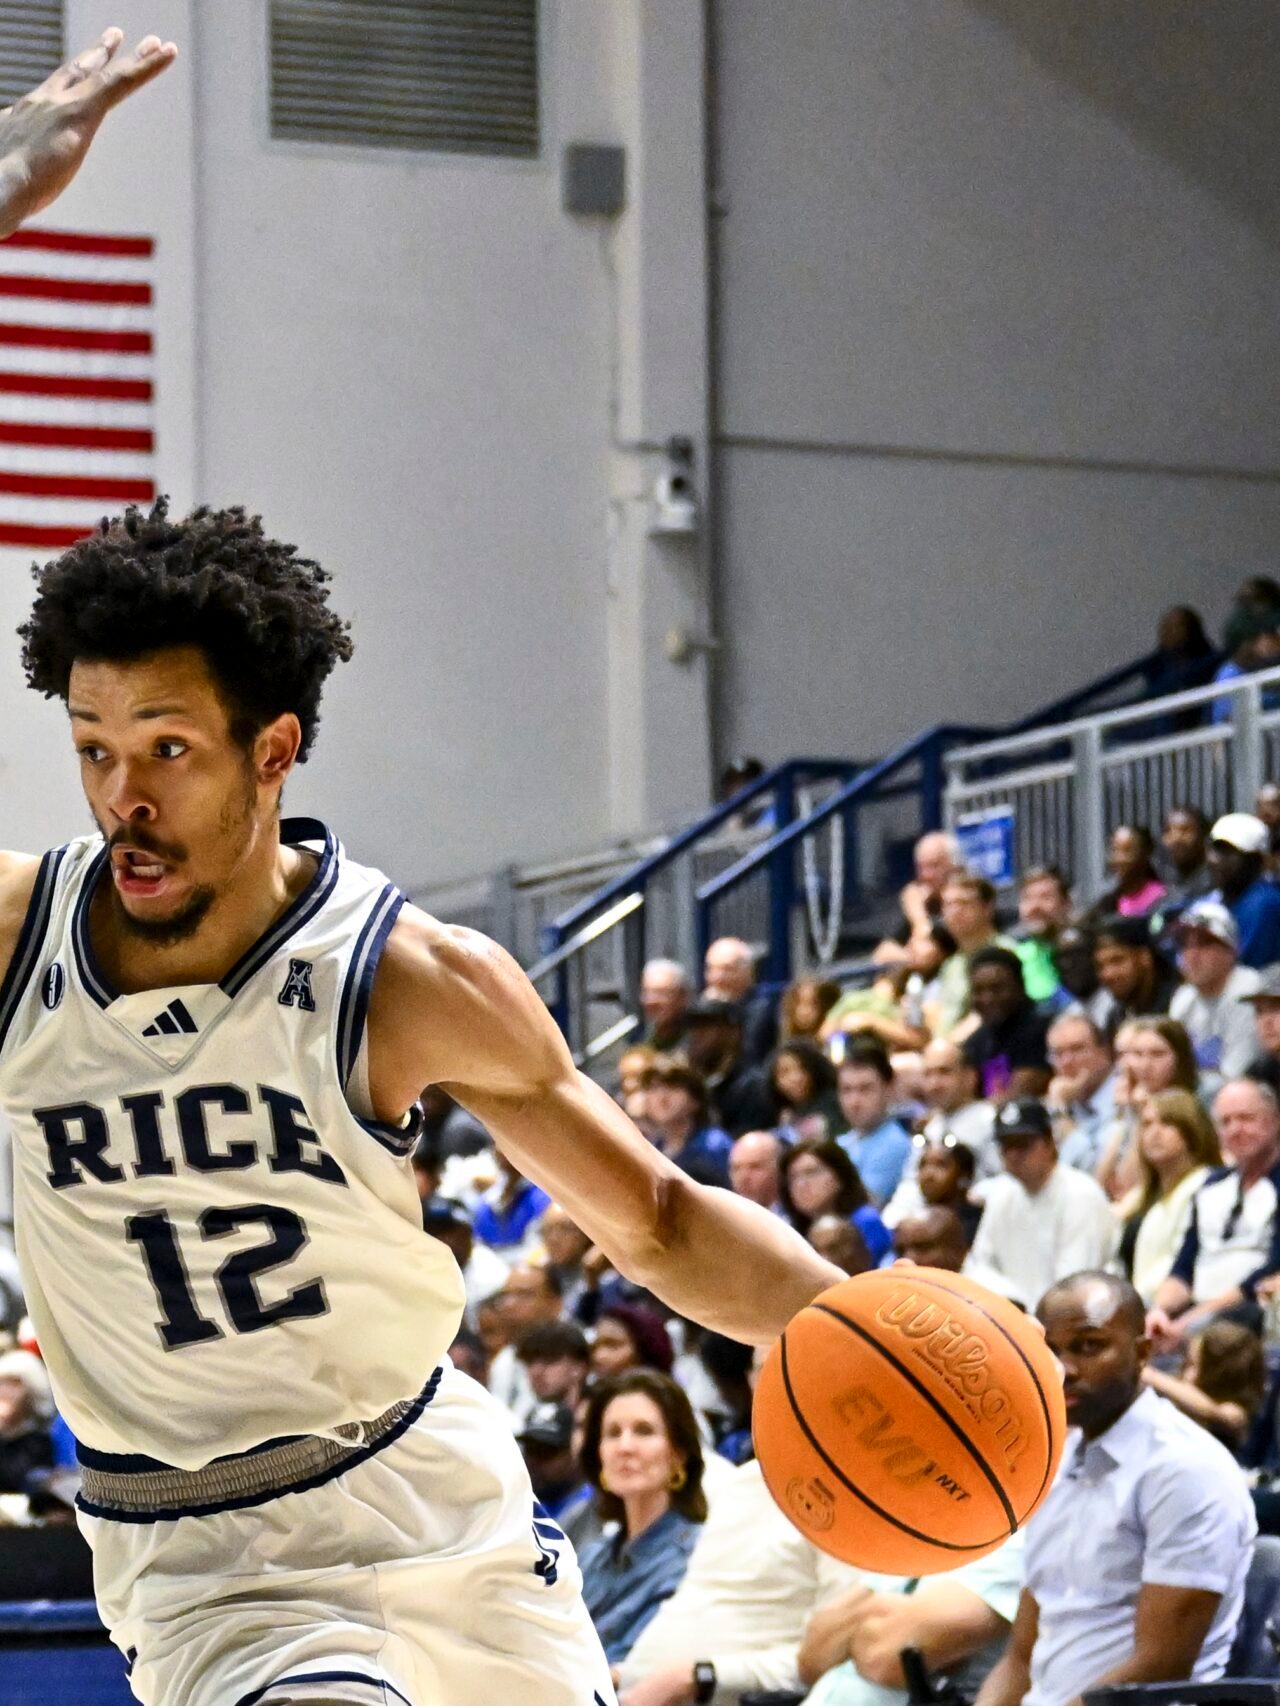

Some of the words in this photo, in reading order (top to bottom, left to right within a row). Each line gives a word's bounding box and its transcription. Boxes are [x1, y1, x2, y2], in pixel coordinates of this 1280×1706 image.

[32, 1082, 349, 1190] RICE
[125, 1203, 331, 1352] 12
[874, 1290, 1029, 1468] Wilson
[935, 1473, 972, 1503] NXT
